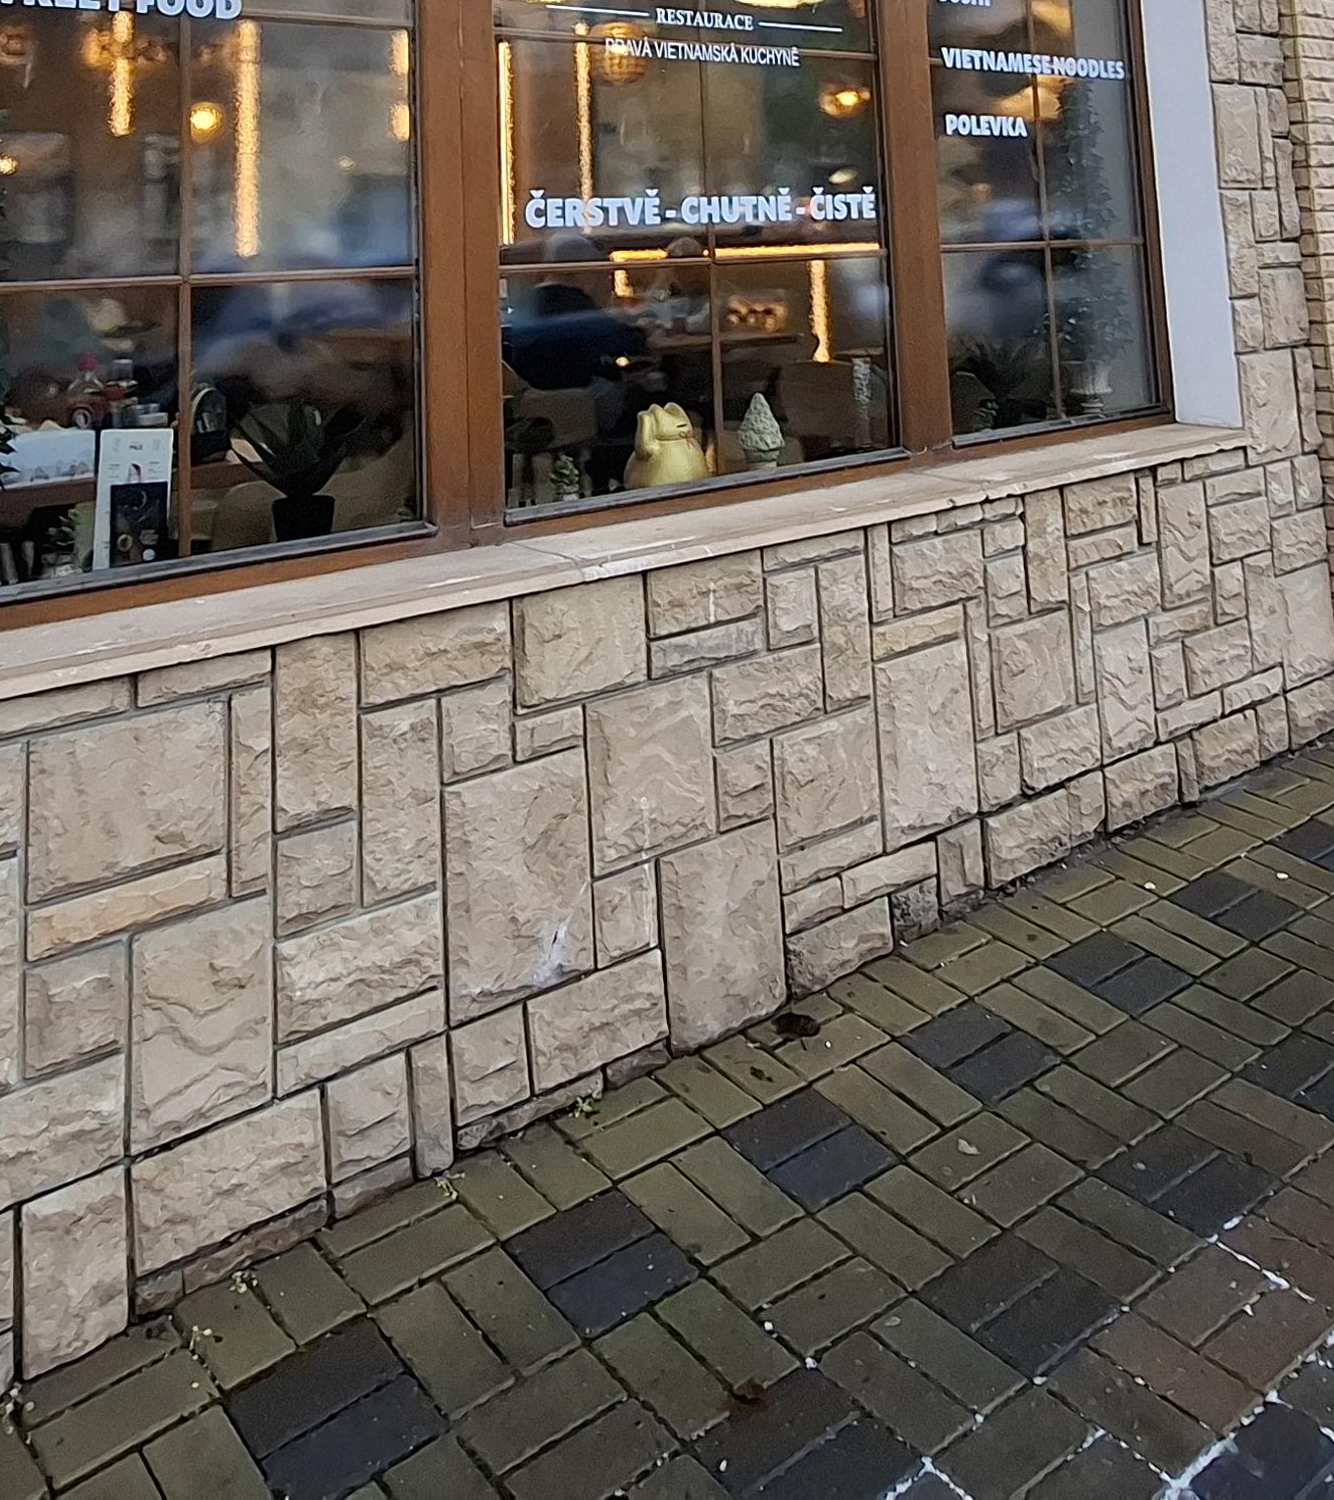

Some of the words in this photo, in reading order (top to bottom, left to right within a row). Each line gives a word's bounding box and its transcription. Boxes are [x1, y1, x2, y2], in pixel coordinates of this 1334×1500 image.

[655, 7, 755, 31] RESTAURACE
[654, 41, 739, 64] VIETNAMSKÁ
[740, 45, 801, 67] KUCHYNĚ
[940, 46, 1051, 77] VIETNAMESE
[1052, 55, 1126, 81] NOODLES
[944, 114, 1029, 139] POLEVKA
[524, 188, 662, 229] ČERSTVĚ
[680, 186, 793, 226] CHUTNĚ
[809, 185, 877, 222] ČISTĚ
